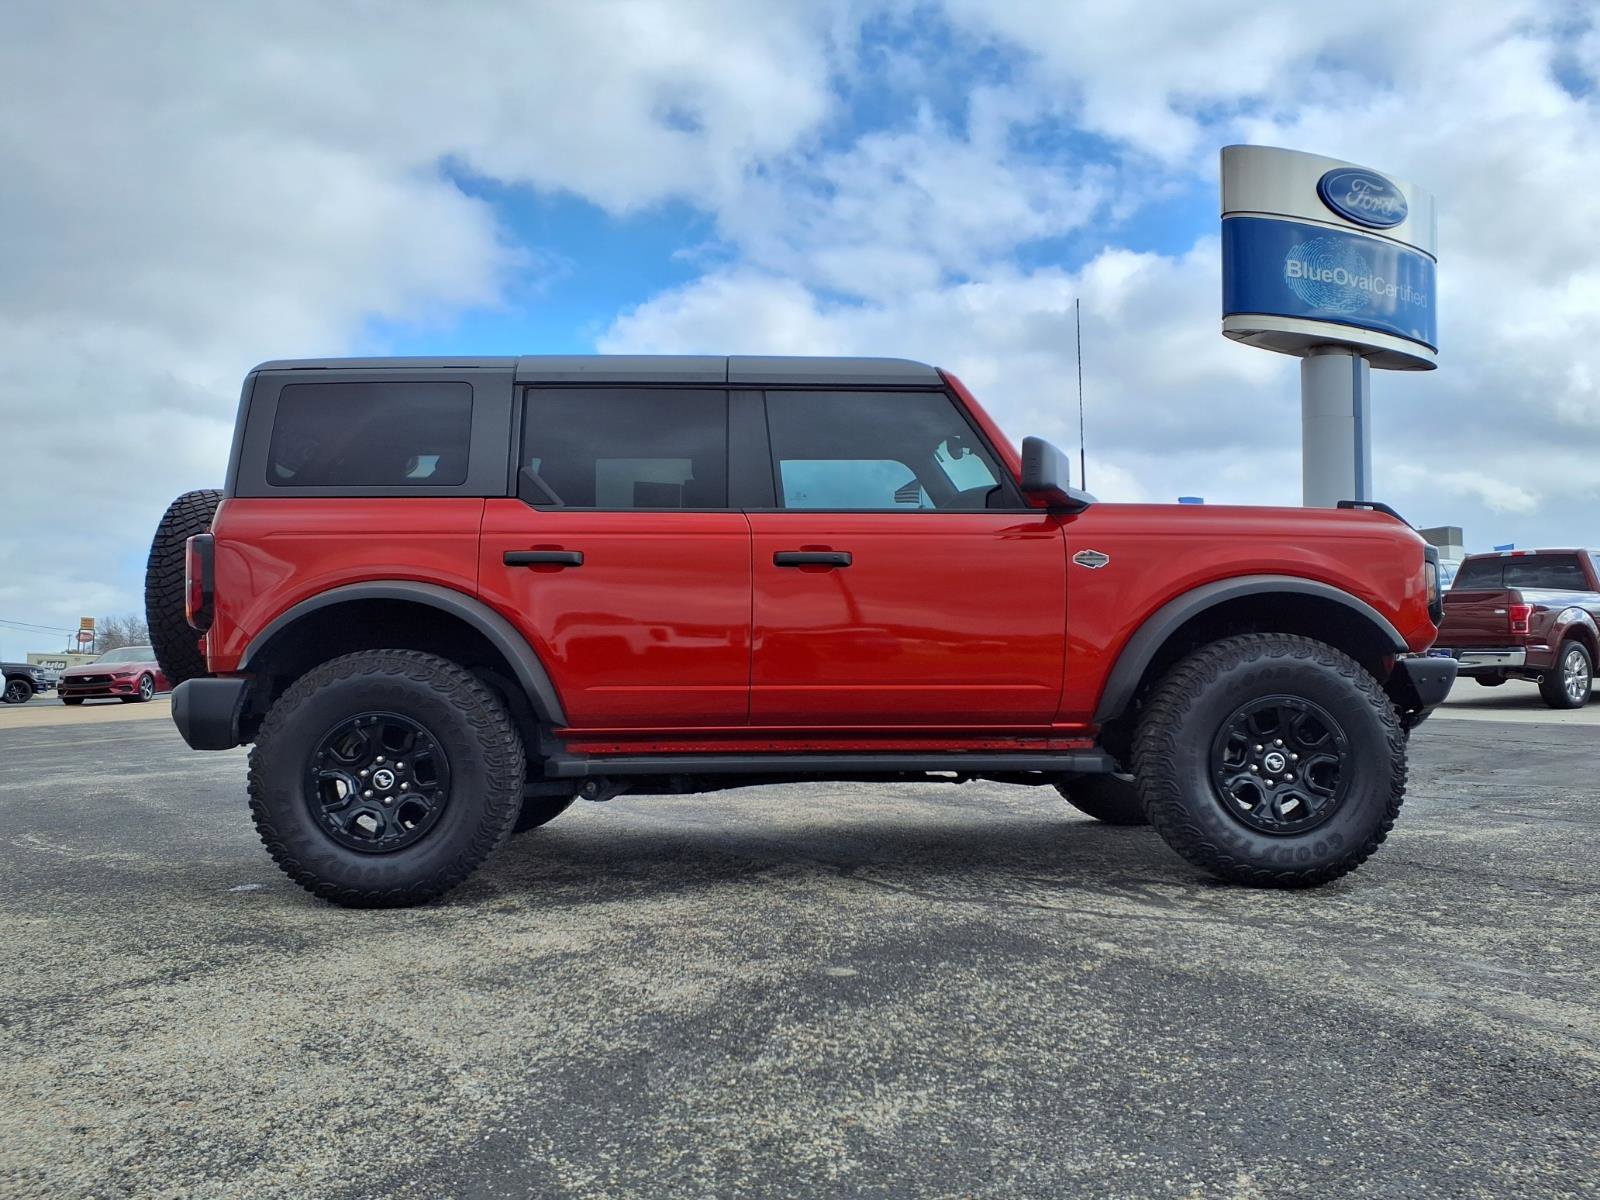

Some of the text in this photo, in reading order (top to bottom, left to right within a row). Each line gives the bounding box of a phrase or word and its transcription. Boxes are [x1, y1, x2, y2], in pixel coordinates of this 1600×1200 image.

[1345, 179, 1395, 216] Ford
[1286, 260, 1427, 308] BlueOvalCertified
[40, 660, 65, 669] Auto
